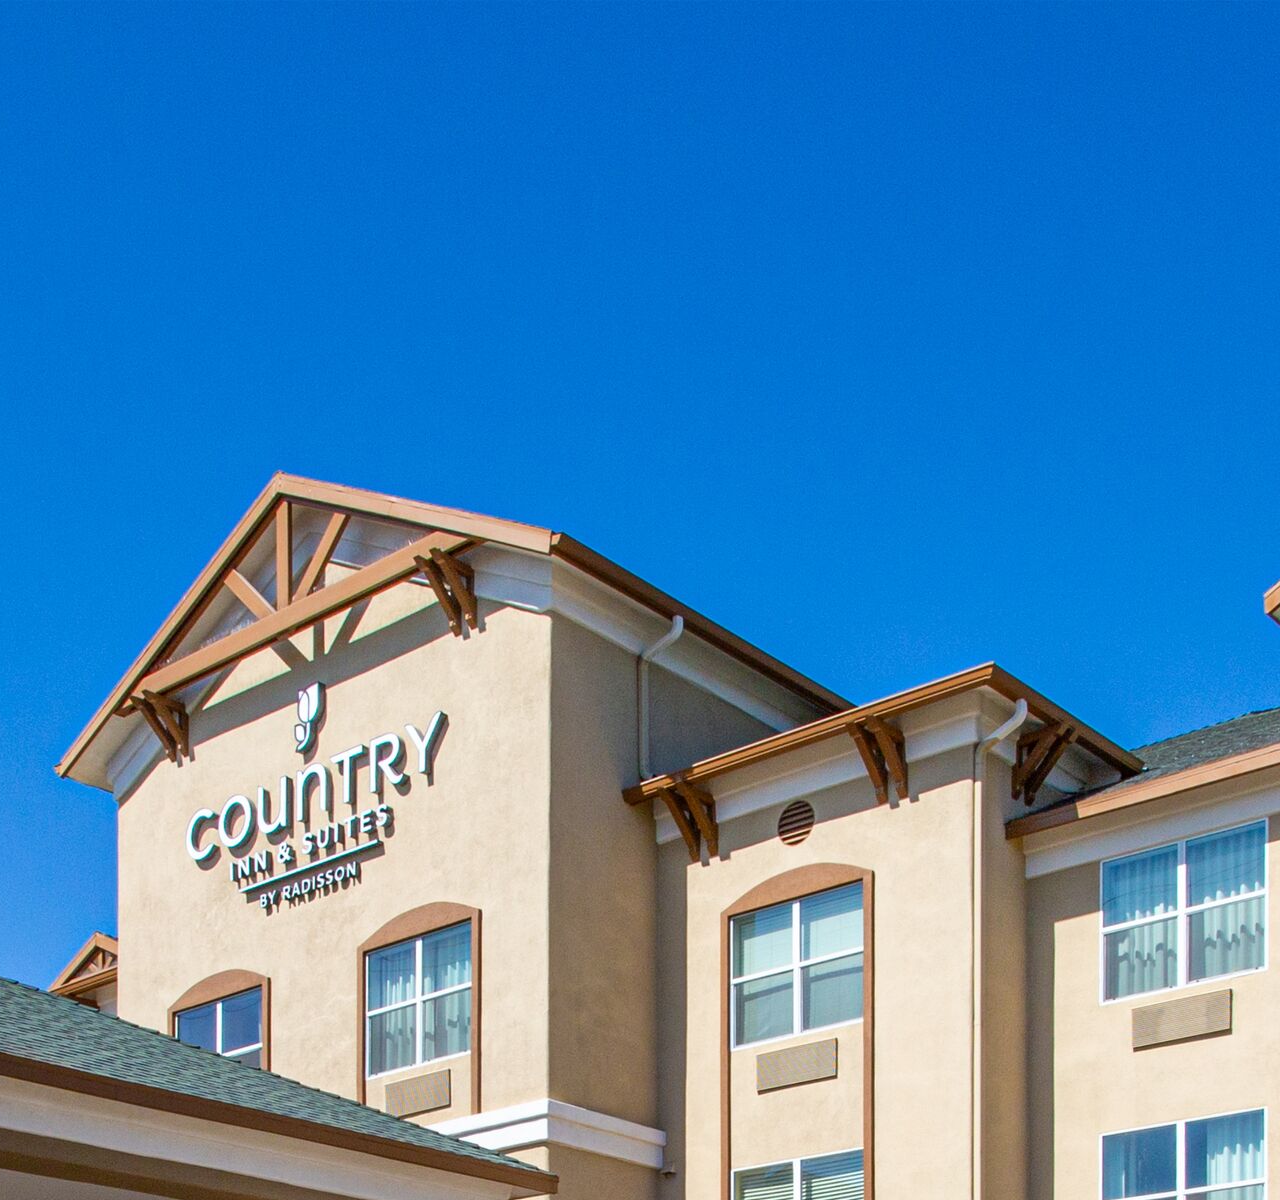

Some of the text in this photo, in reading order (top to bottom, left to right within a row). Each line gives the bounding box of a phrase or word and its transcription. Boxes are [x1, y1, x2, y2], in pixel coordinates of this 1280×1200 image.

[229, 804, 390, 882] INN & SUITES
[259, 862, 357, 908] BY RADISSON
